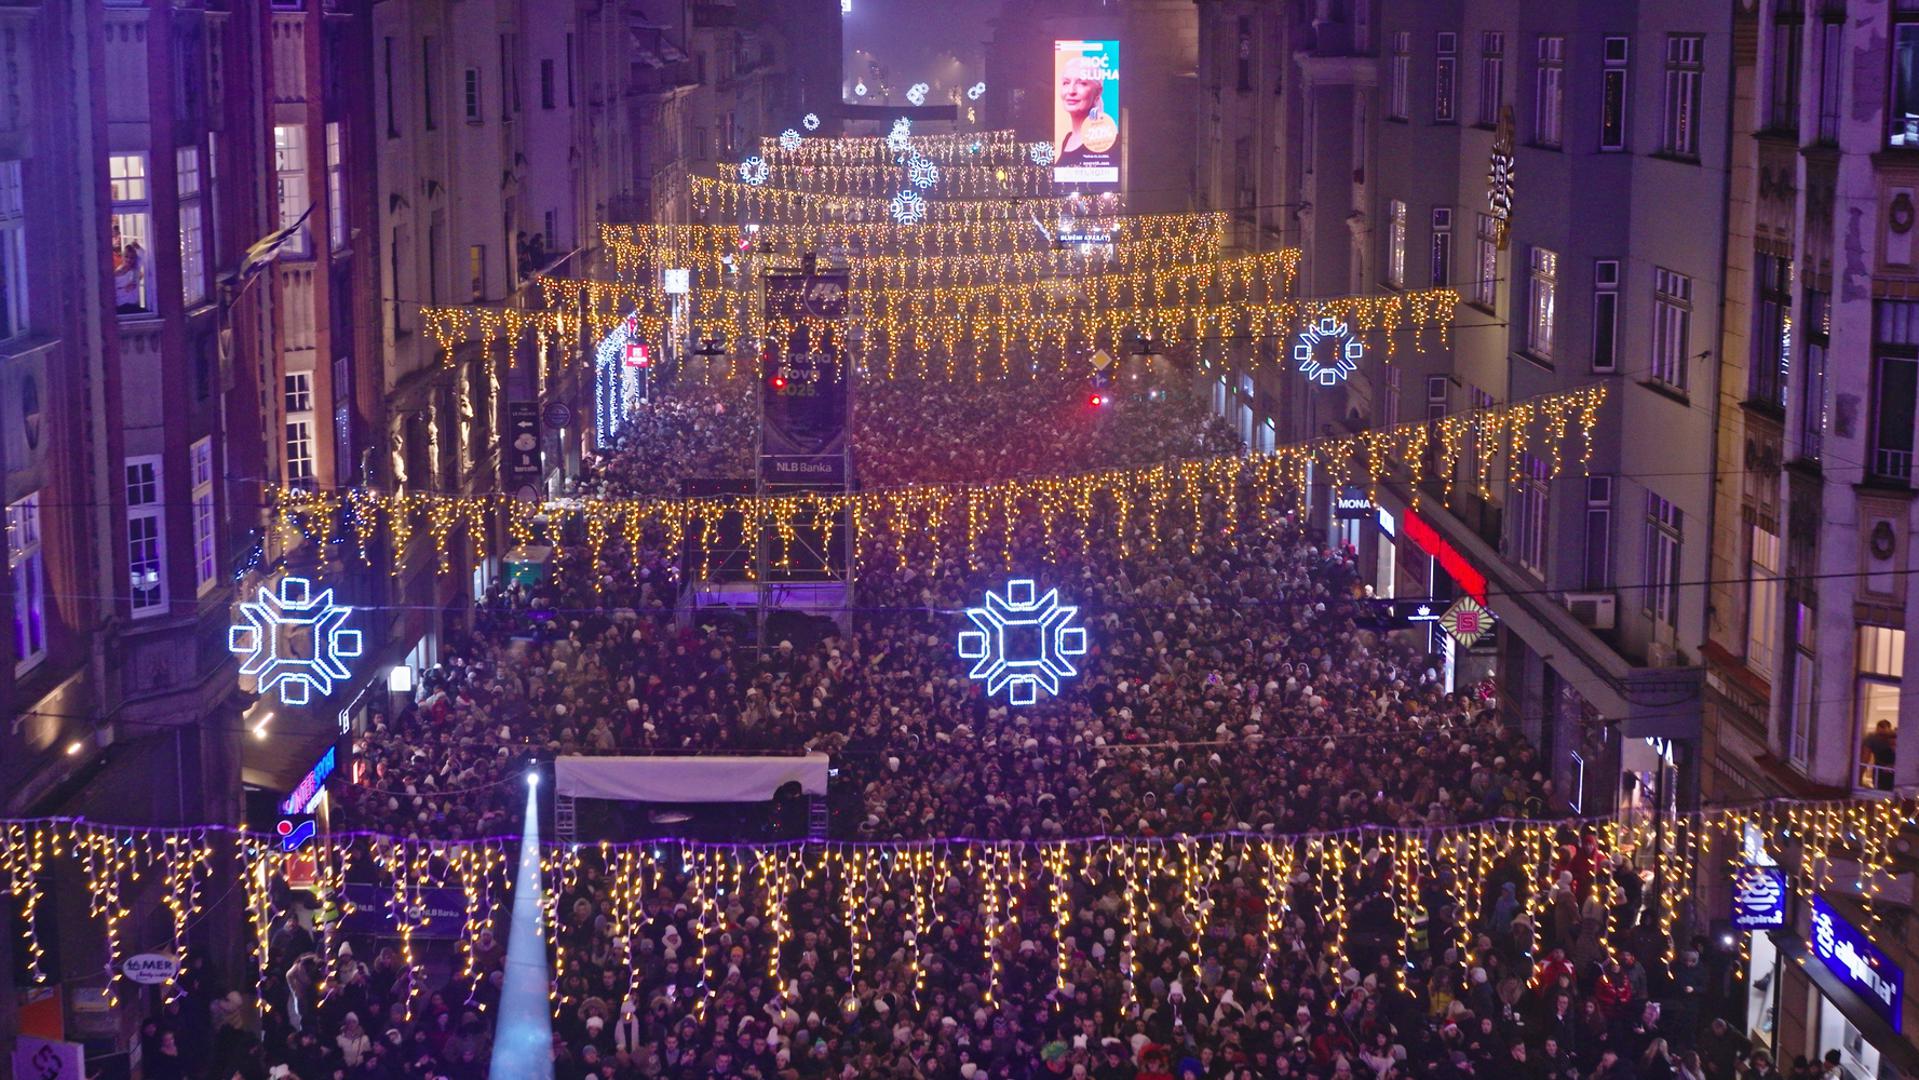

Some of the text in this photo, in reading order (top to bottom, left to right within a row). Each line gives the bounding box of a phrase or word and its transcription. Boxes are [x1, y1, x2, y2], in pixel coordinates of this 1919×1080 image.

[777, 462, 832, 472] NLB Banka
[1338, 499, 1371, 509] MONA
[142, 960, 172, 970] MER
[1834, 940, 1892, 1006] alpina
